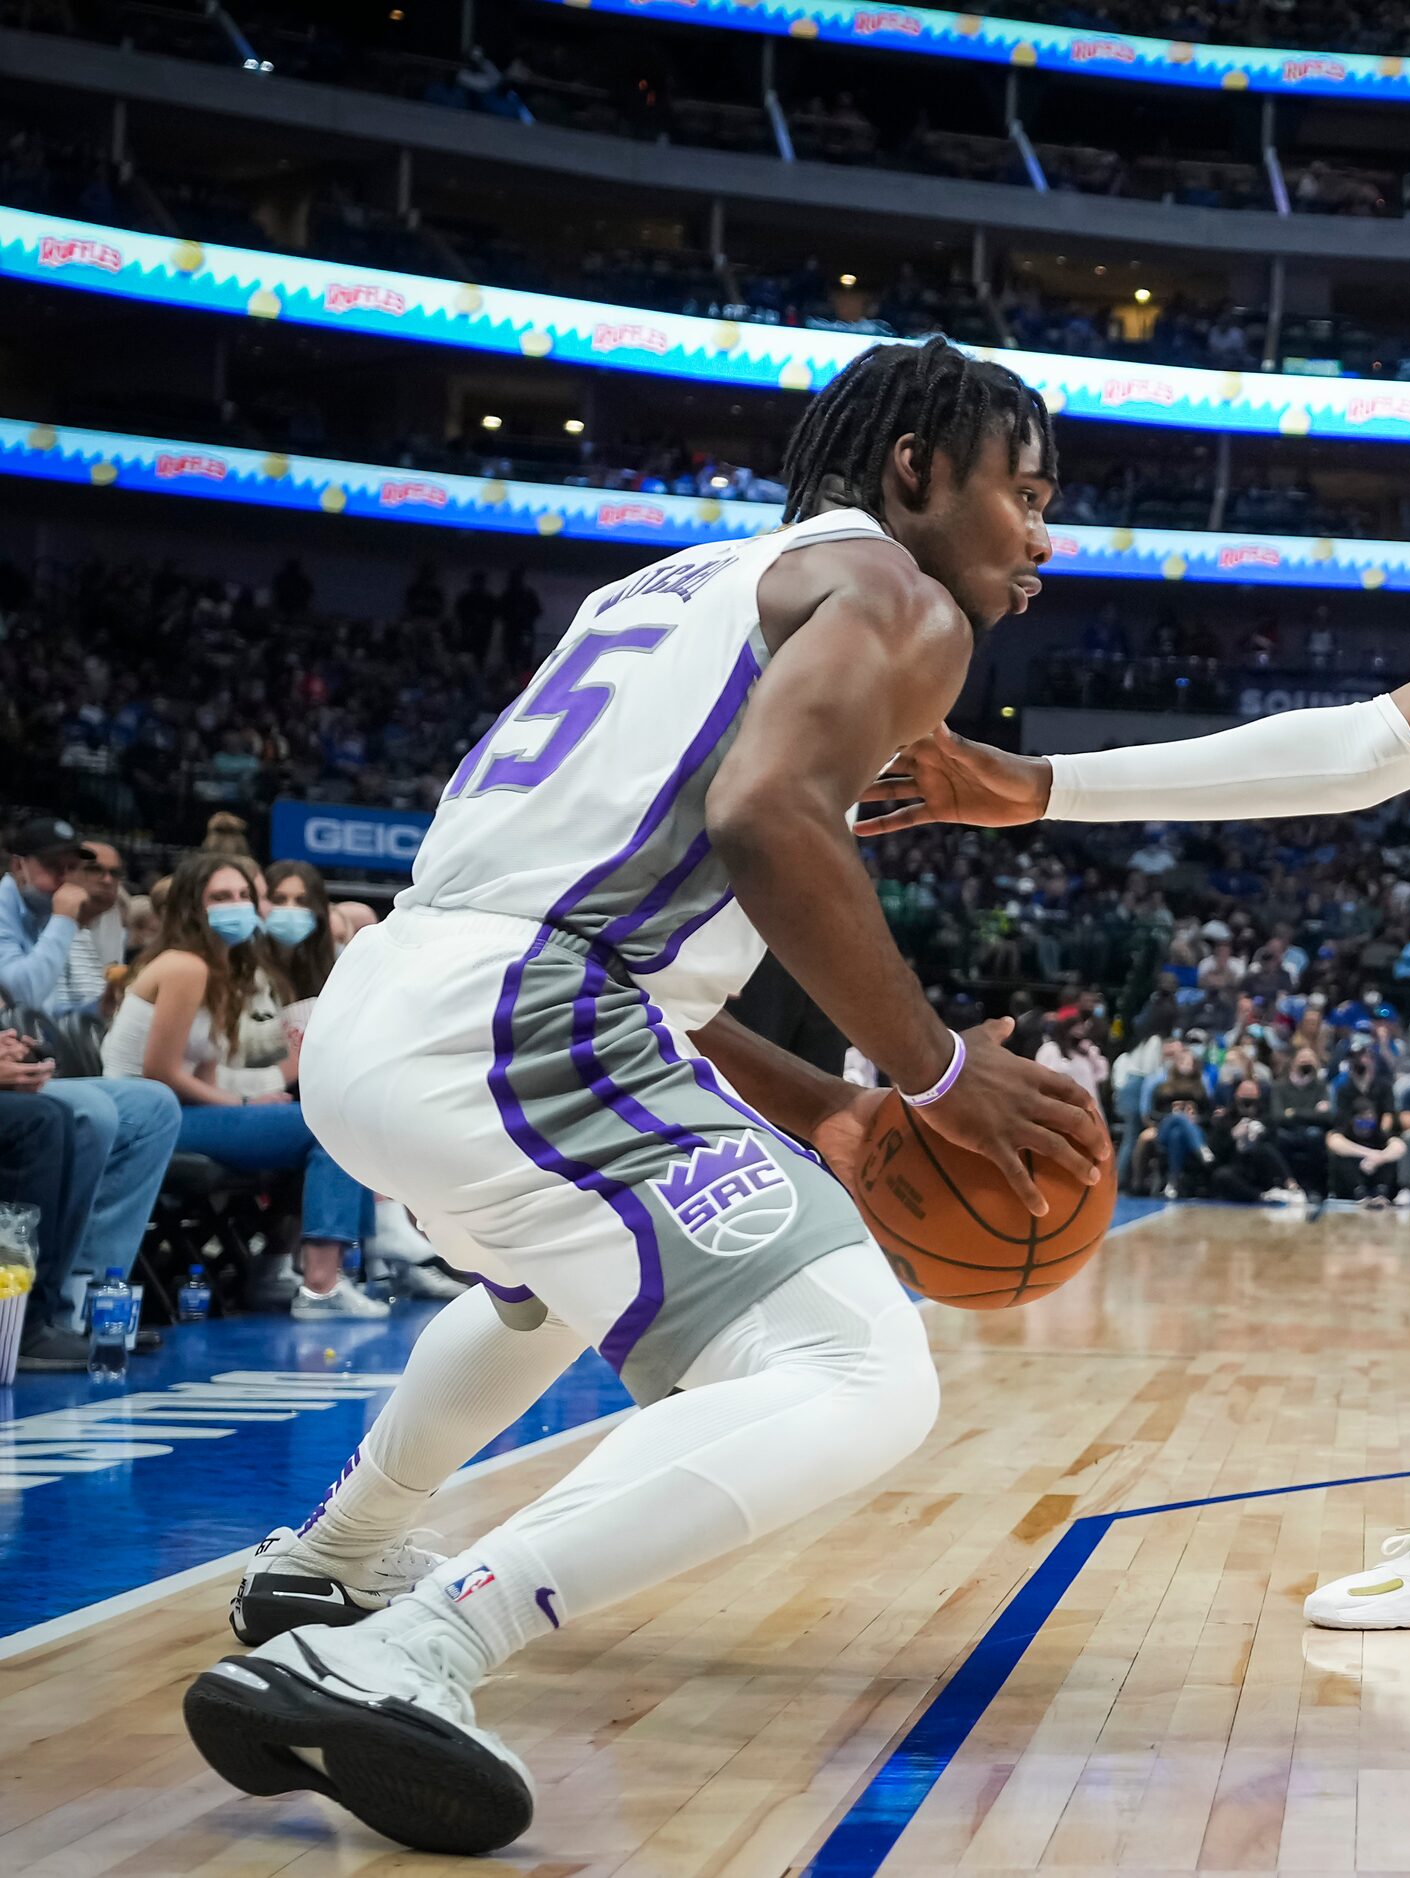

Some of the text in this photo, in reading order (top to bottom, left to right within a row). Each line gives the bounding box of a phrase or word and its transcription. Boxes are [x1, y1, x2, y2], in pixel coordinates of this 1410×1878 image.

[39, 237, 121, 272] RUFFLES
[325, 283, 405, 316] RUFFLES
[593, 324, 667, 355] RUFFLES
[303, 816, 427, 860] GEIC
[677, 1159, 786, 1234] SAC
